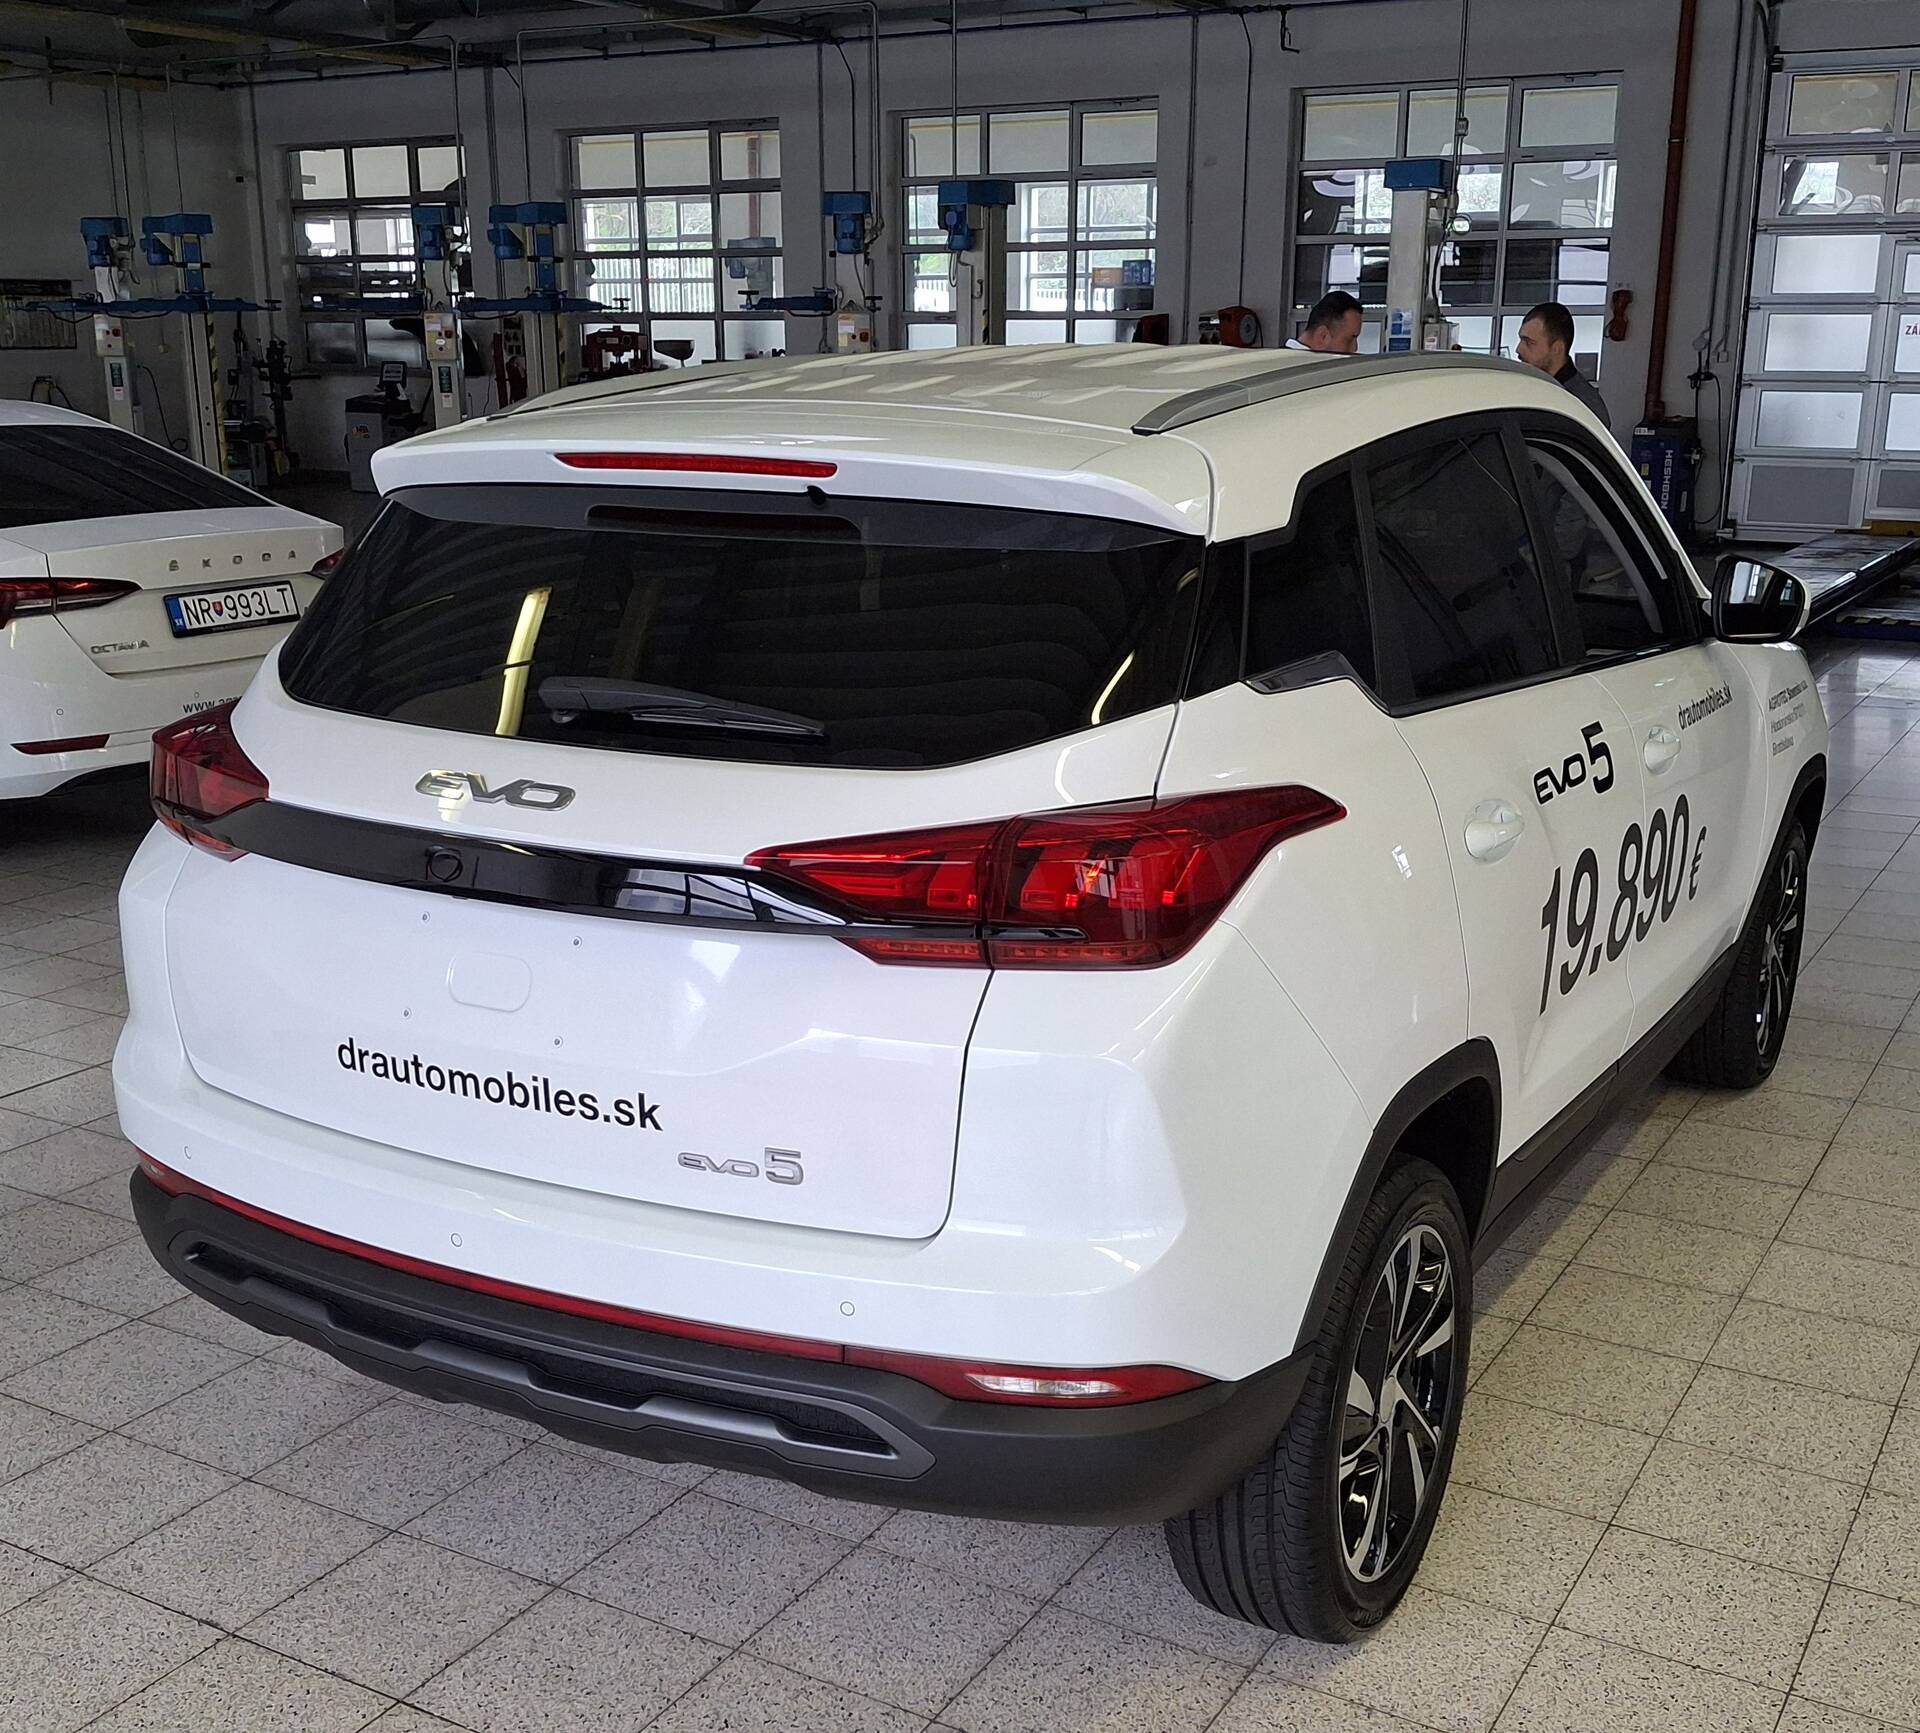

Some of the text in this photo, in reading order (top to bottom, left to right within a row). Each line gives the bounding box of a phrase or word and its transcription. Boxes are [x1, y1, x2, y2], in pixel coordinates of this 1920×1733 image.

[1905, 322, 1920, 335] ZÁ
[1660, 449, 1674, 510] HESHBON
[90, 640, 150, 654] OCTAVIA
[1678, 680, 1733, 731] drautomobiles.sk
[415, 769, 576, 811] EVO
[337, 1037, 664, 1132] drautomobiles.sk
